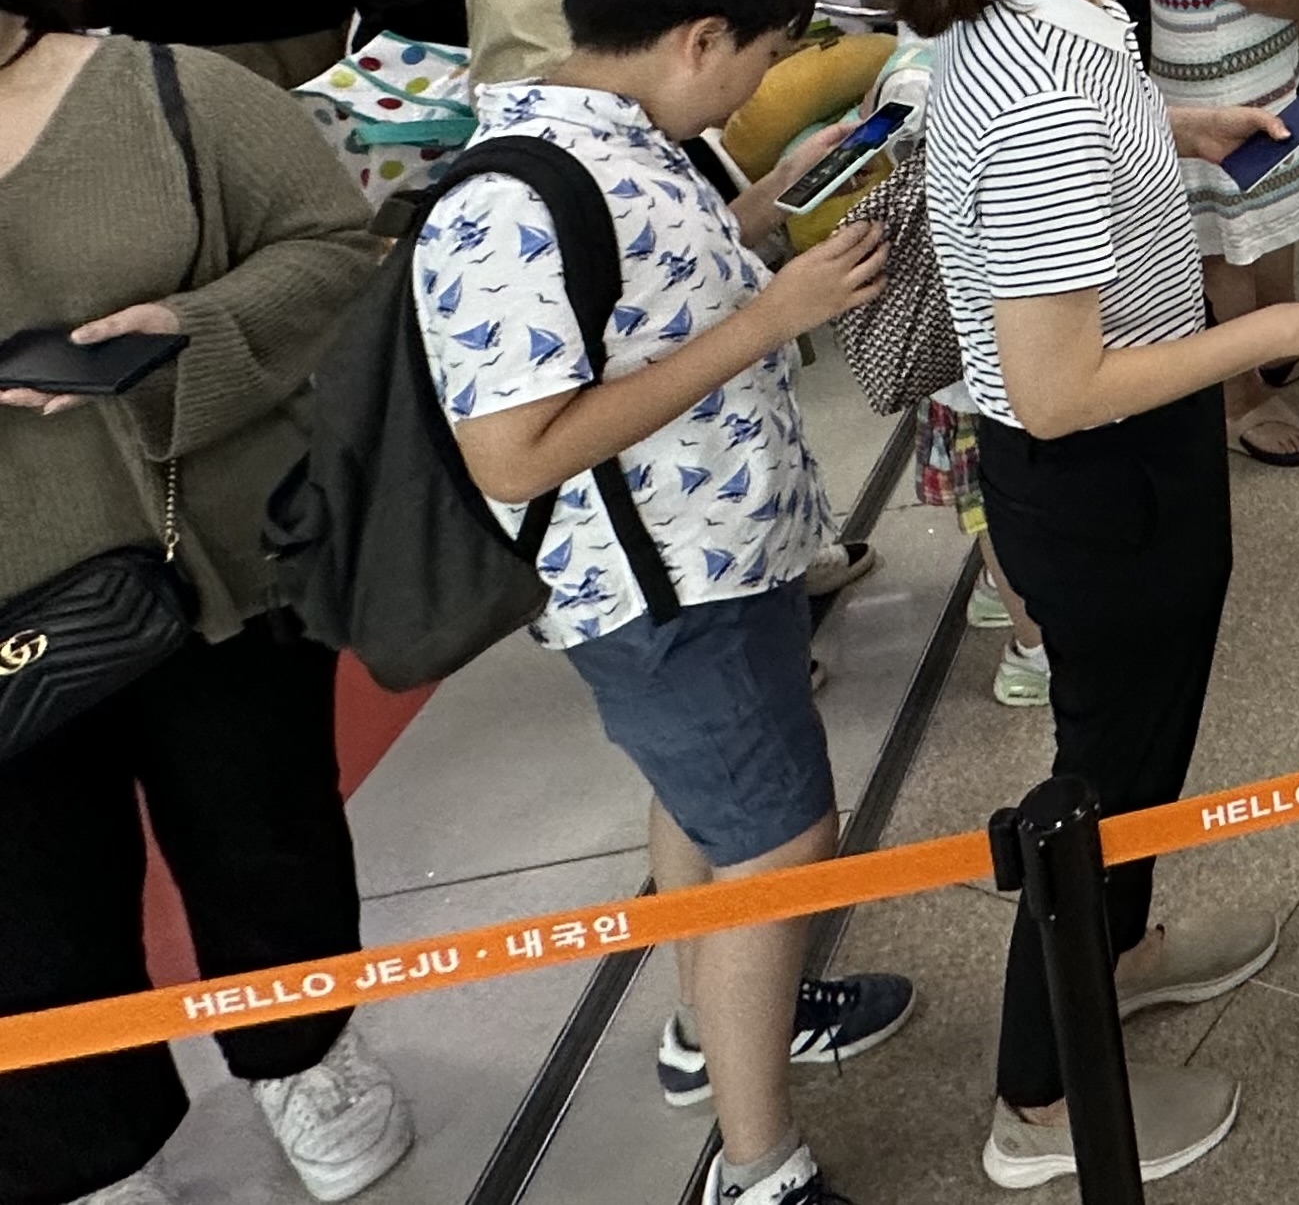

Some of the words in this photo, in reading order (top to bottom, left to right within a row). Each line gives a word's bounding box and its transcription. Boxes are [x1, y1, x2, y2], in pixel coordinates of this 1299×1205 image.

[184, 973, 335, 1018] HELLO
[355, 947, 460, 986] JEJU
[507, 911, 631, 960] 내국인
